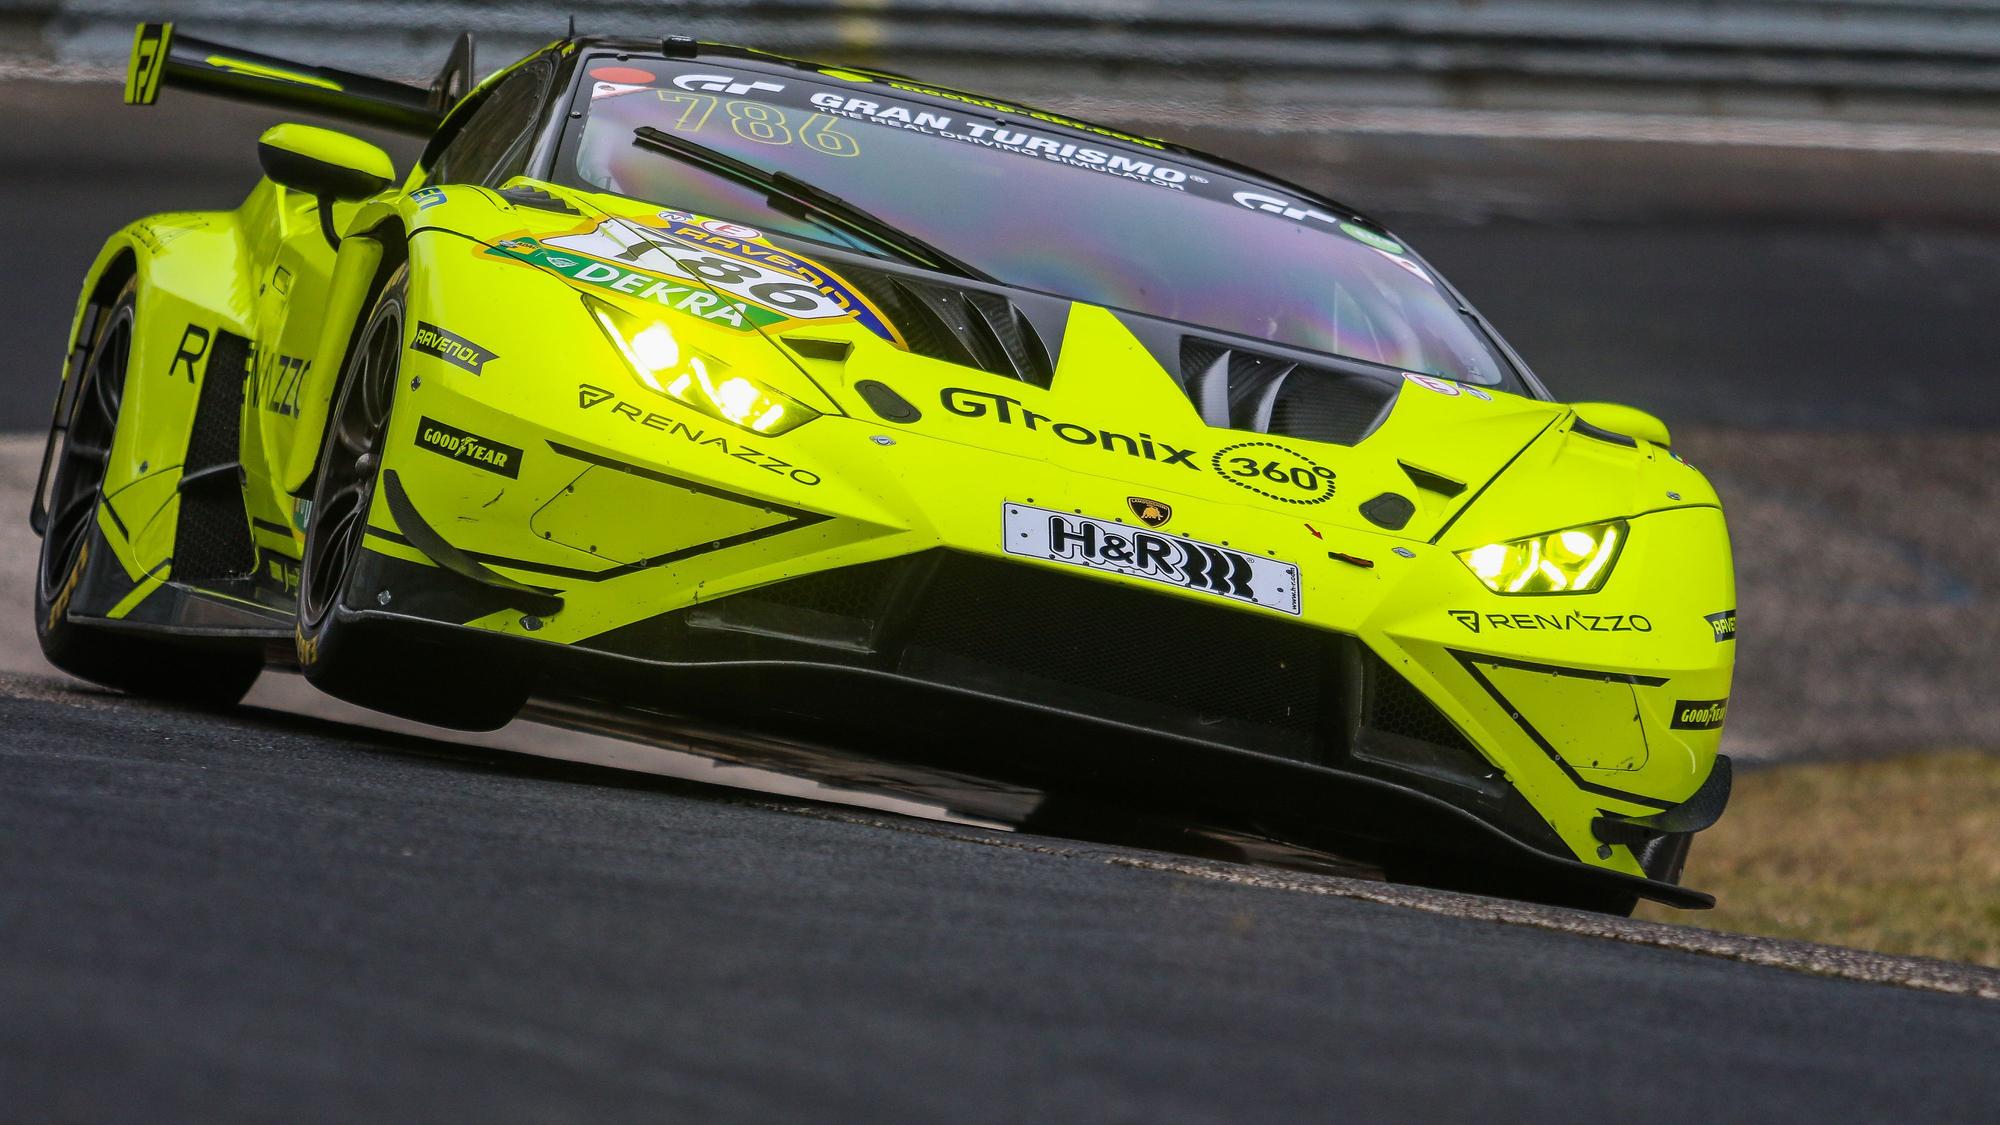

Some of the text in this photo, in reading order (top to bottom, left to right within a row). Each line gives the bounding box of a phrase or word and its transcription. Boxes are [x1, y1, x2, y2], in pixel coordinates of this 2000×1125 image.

[656, 89, 860, 157] 786
[810, 92, 952, 130] GRAN
[814, 105, 1186, 191] THE REAL DRIVING SIMULATOR
[574, 262, 748, 328] DEKRA
[614, 227, 819, 311] 786
[675, 227, 861, 319] RAVENOL
[417, 328, 480, 367] RAVENOL
[611, 400, 822, 488] RENAZZO
[940, 387, 1203, 472] GTronix
[1289, 567, 1297, 610] www.h-r.com
[1490, 612, 1653, 633] RENAZZO
